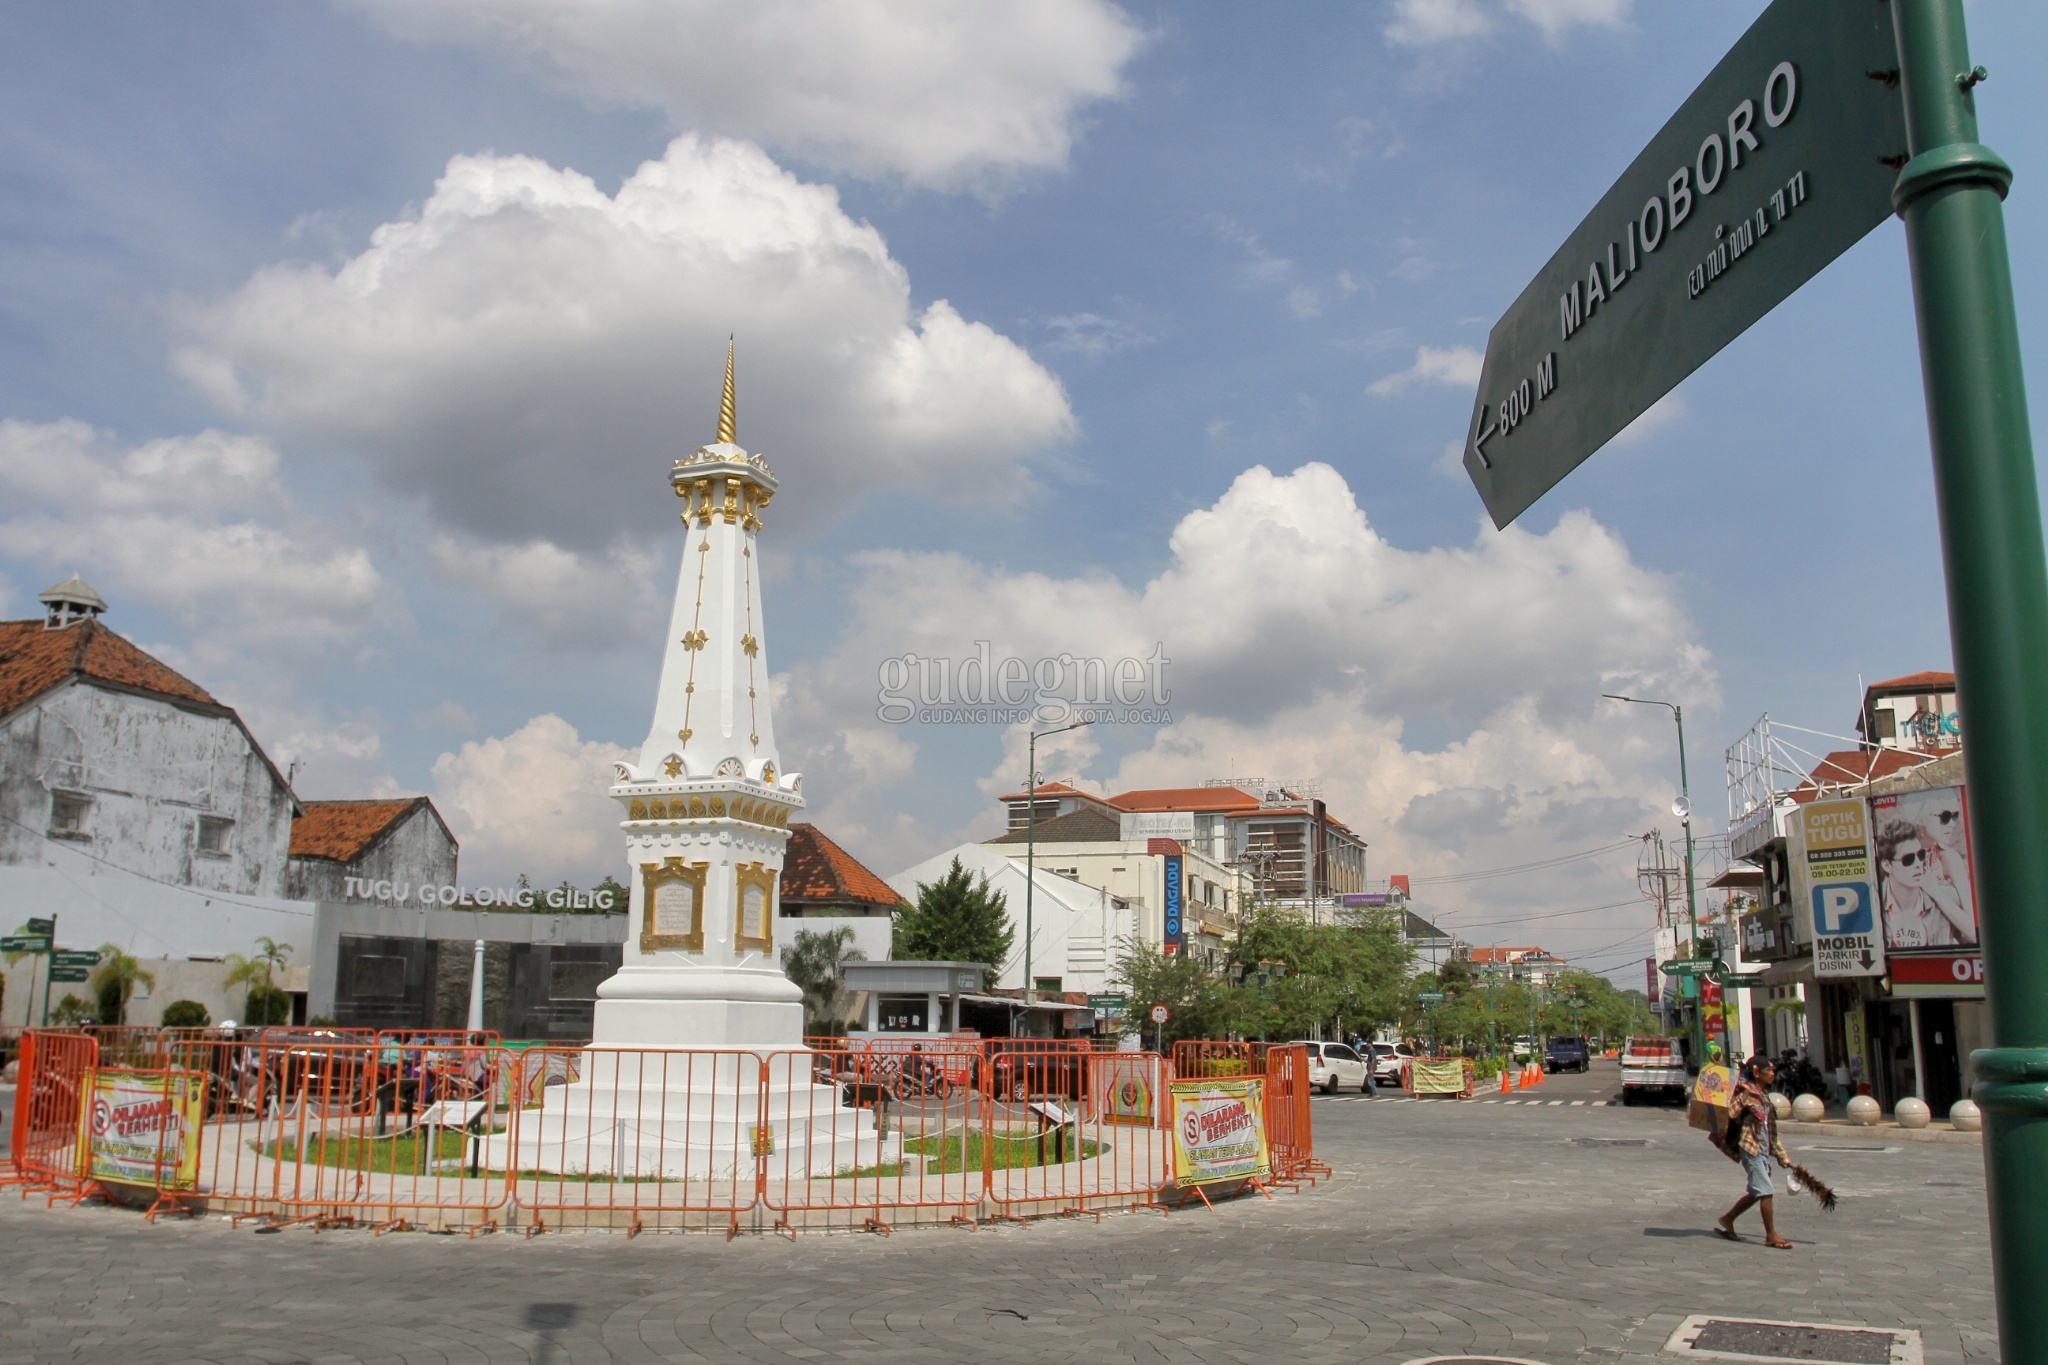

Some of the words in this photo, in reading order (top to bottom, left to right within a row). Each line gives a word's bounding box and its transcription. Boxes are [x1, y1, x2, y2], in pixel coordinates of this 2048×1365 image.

[1560, 61, 1796, 341] MALIOBORO
[1500, 378, 1530, 436] 800
[1537, 352, 1554, 401] M
[1810, 811, 1856, 827] OPTIK
[1807, 823, 1863, 843] TUGU
[1811, 868, 1866, 879] 09.00-22.00
[1829, 862, 1847, 870] TETAP
[344, 876, 409, 901] TUGU
[418, 884, 534, 908] GOLONG
[546, 888, 614, 909] GILIG
[1167, 861, 1179, 917] DAGADU
[1822, 887, 1860, 931] P
[1816, 936, 1874, 951] MOBIL
[1818, 950, 1860, 961] PARKIR
[1819, 960, 1852, 971] DISINI
[117, 1113, 179, 1136] BERHETI
[1200, 1101, 1247, 1131] DILARANG
[1206, 1113, 1253, 1141] BERHENTI
